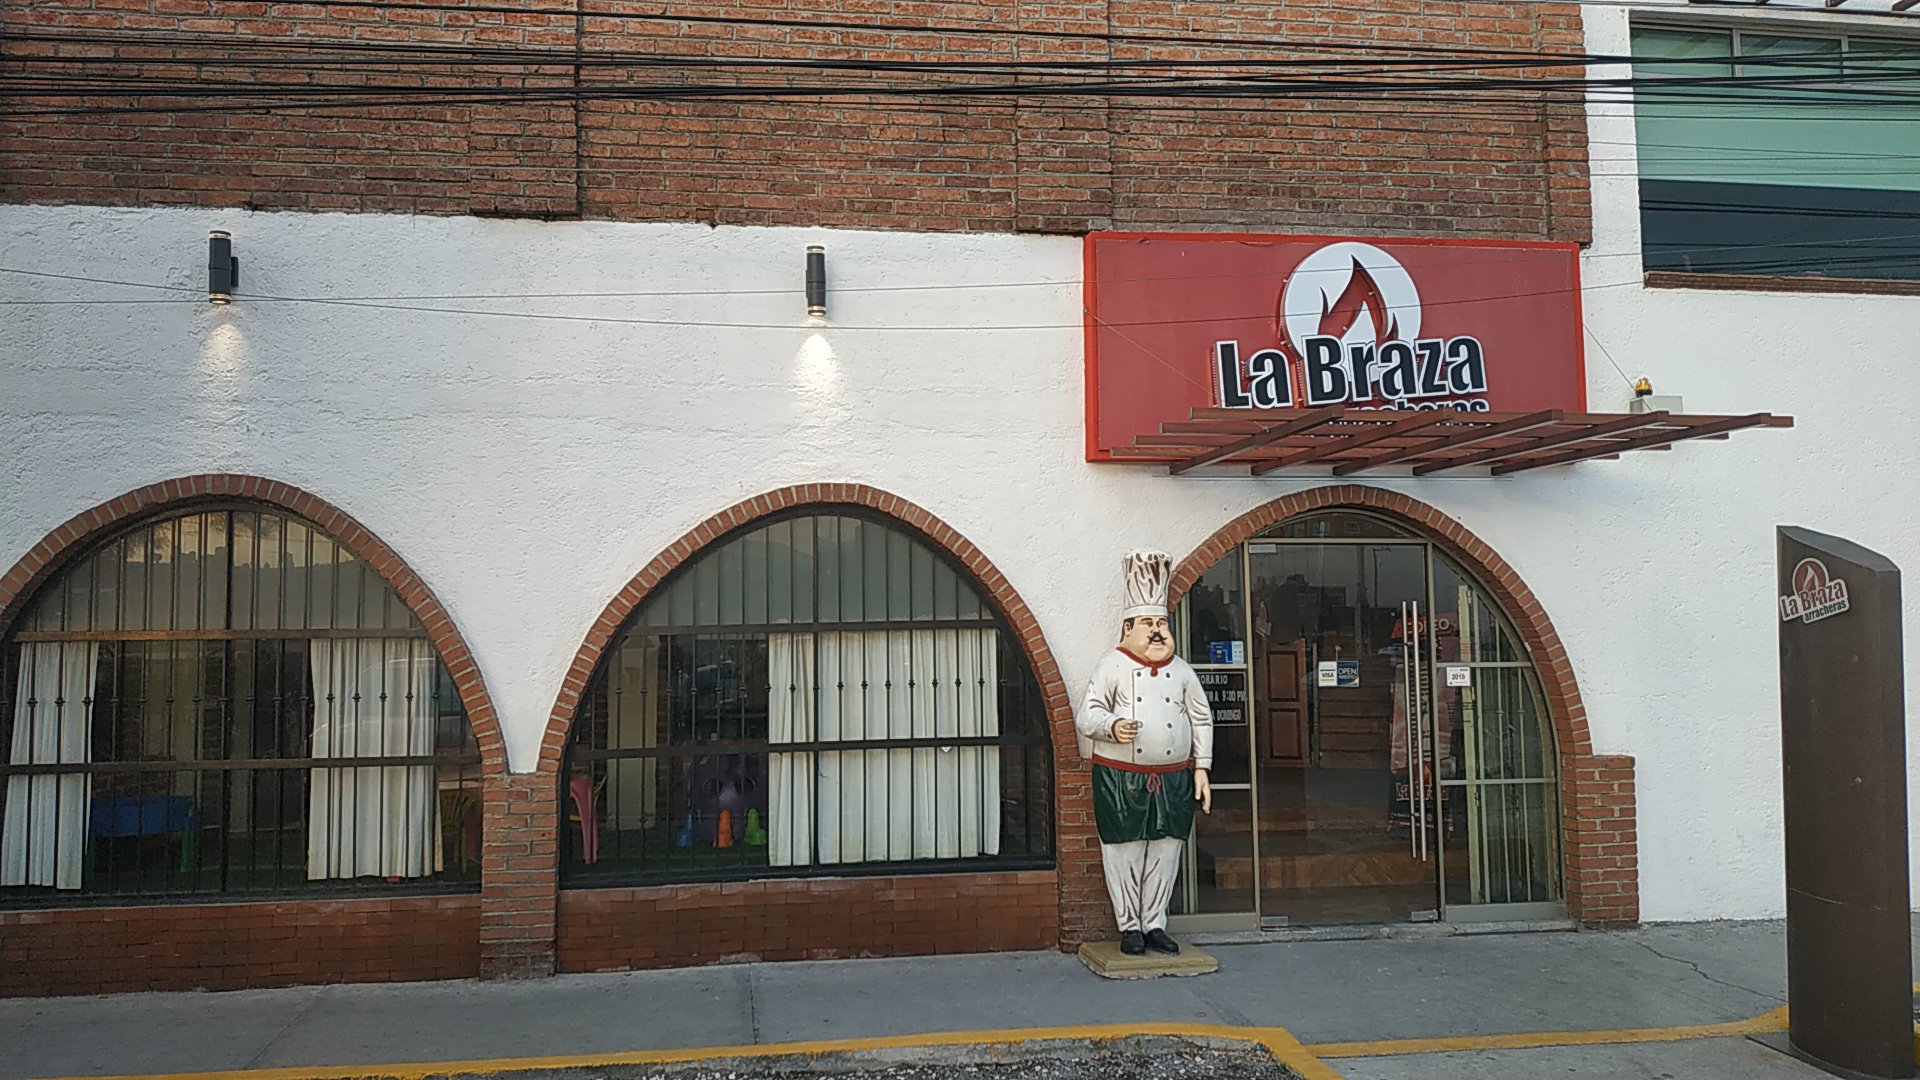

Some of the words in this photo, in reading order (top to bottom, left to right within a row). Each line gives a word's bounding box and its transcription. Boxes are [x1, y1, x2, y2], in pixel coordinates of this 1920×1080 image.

[1216, 340, 1293, 409] La
[1301, 335, 1488, 405] Braza
[1780, 596, 1798, 618] La
[1800, 581, 1845, 611] Braza
[1805, 600, 1846, 621] arracheras
[1338, 667, 1357, 675] OPEN
[1217, 709, 1241, 720] DOMINGO
